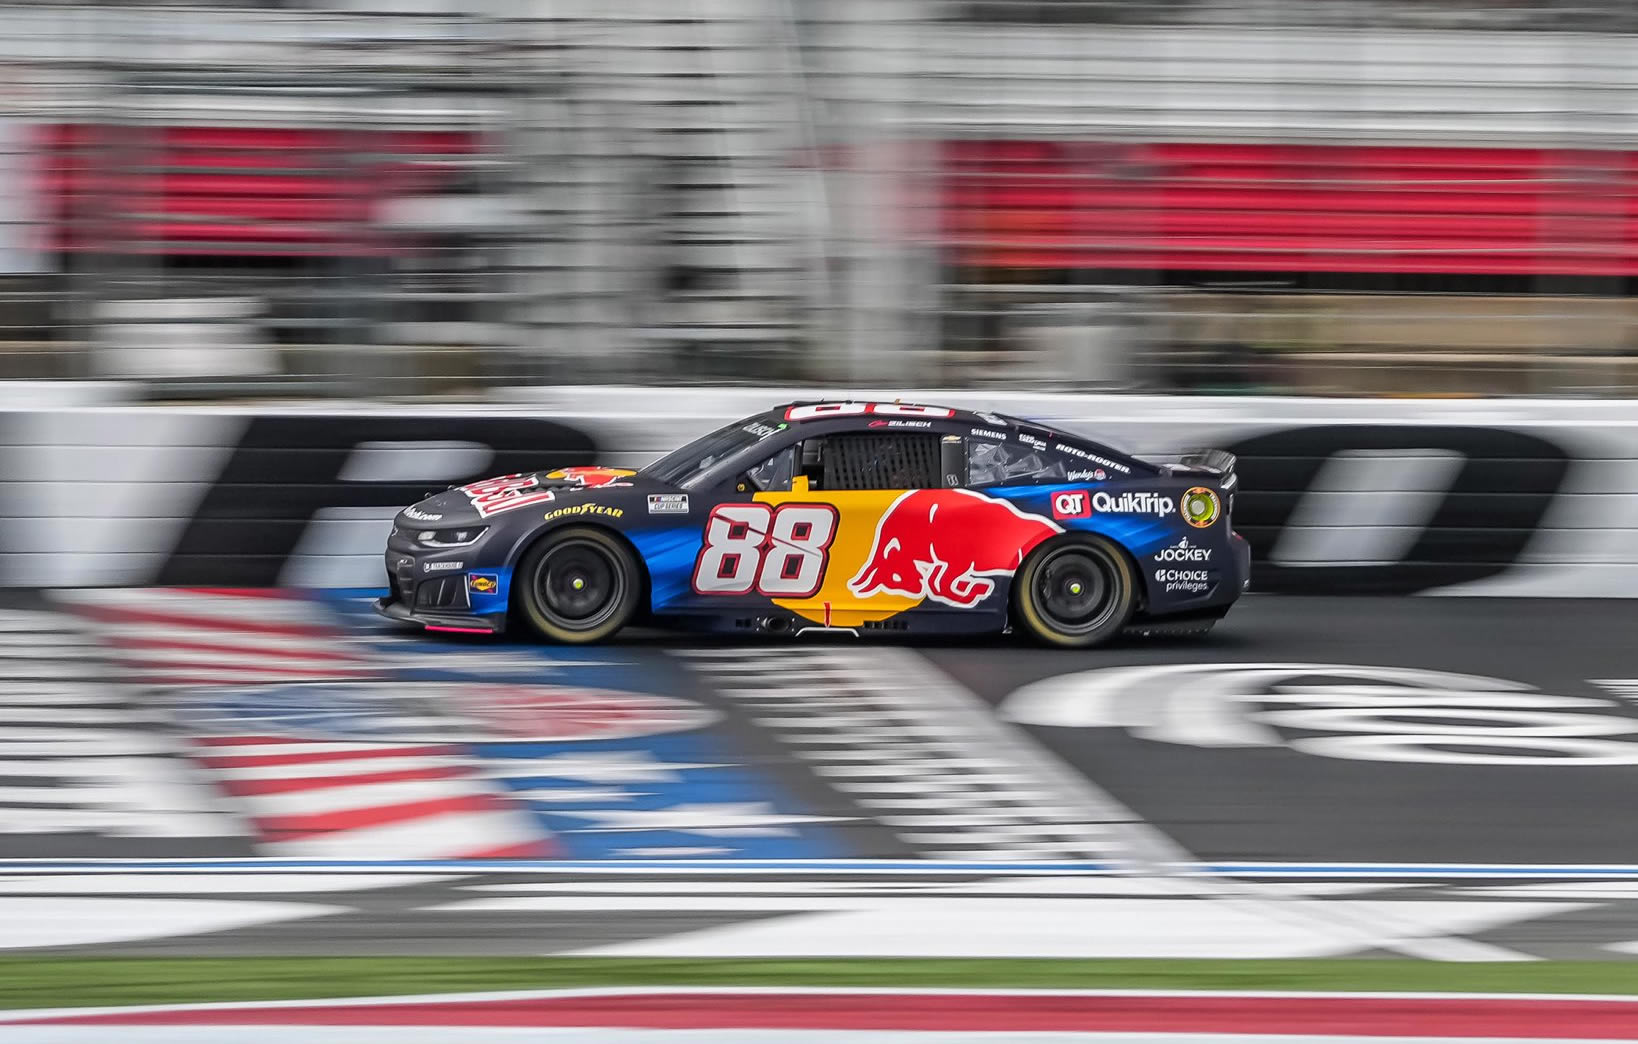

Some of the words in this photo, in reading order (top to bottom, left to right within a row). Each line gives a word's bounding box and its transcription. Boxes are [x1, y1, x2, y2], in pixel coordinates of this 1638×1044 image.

[970, 428, 1007, 441] SIEMENS
[544, 503, 624, 520] GOODYEAR
[1055, 494, 1083, 514] QT
[692, 503, 838, 596] 88
[1154, 548, 1212, 562] JOCKEY
[1166, 570, 1208, 581] CHOICE
